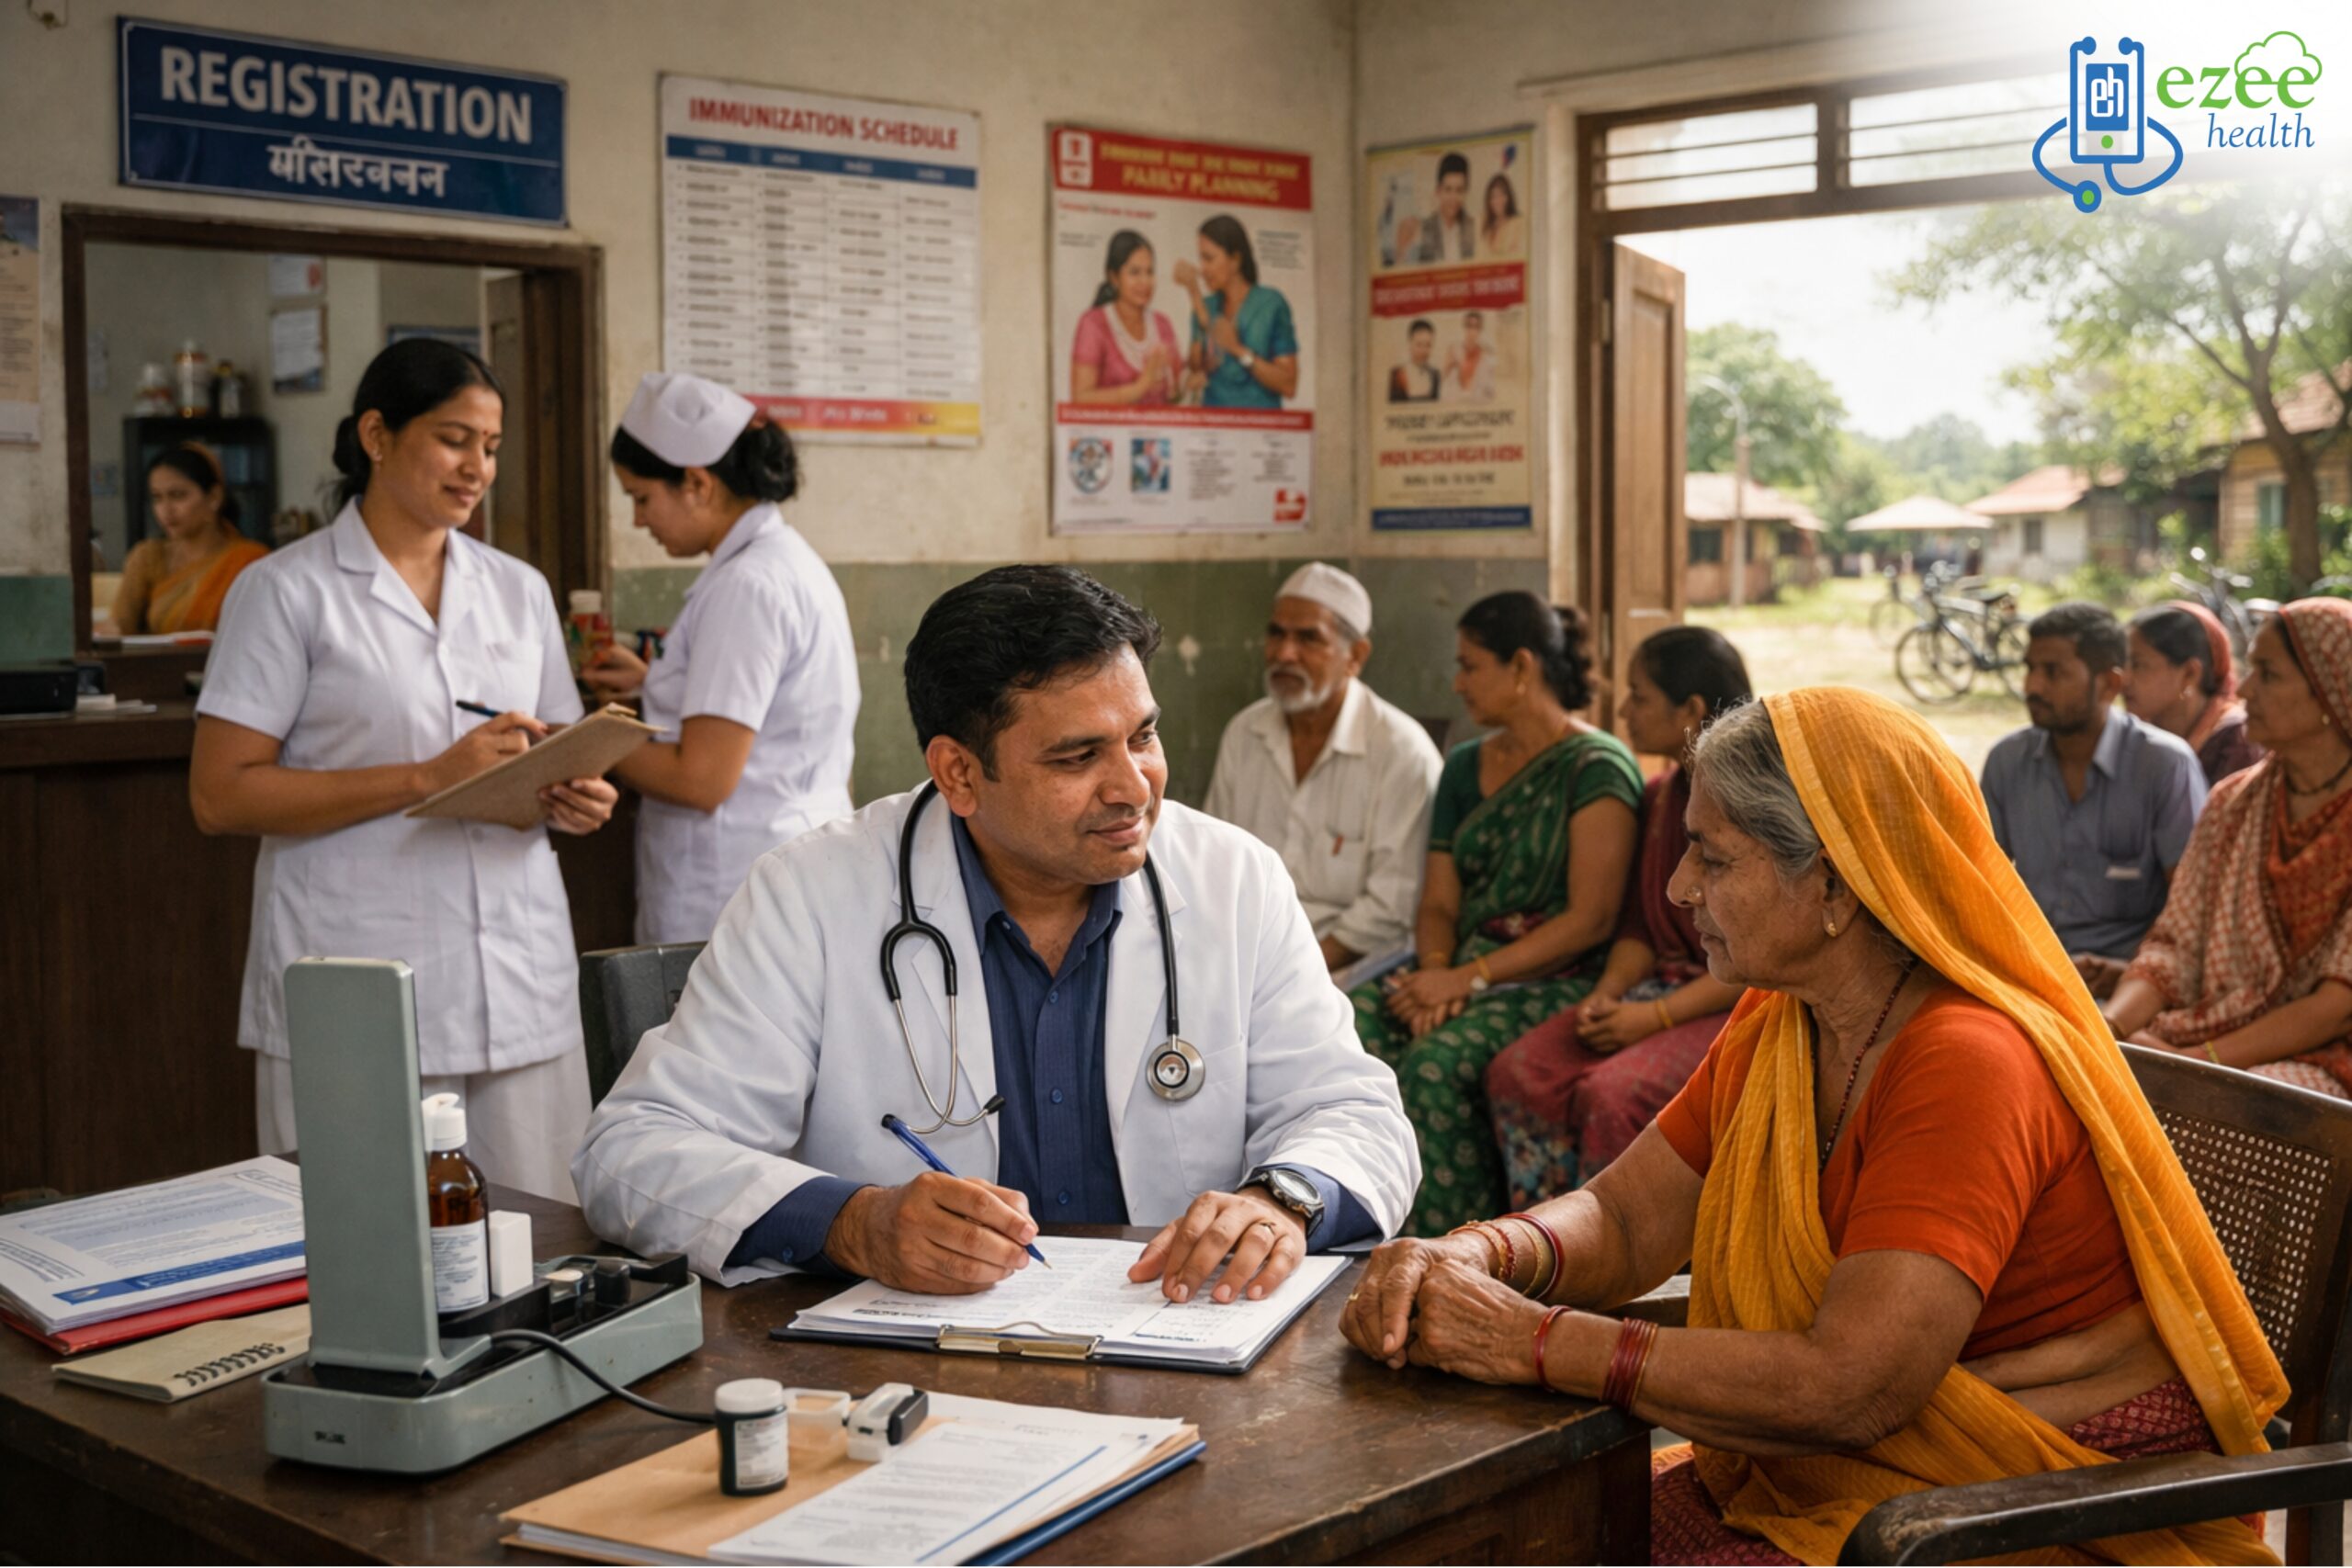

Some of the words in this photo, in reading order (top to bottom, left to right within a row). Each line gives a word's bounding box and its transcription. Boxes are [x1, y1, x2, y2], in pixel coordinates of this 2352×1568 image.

[161, 46, 532, 144] REGISTRATION
[690, 97, 854, 139] IMMUNIZATION
[859, 117, 958, 151] SCHEDULE
